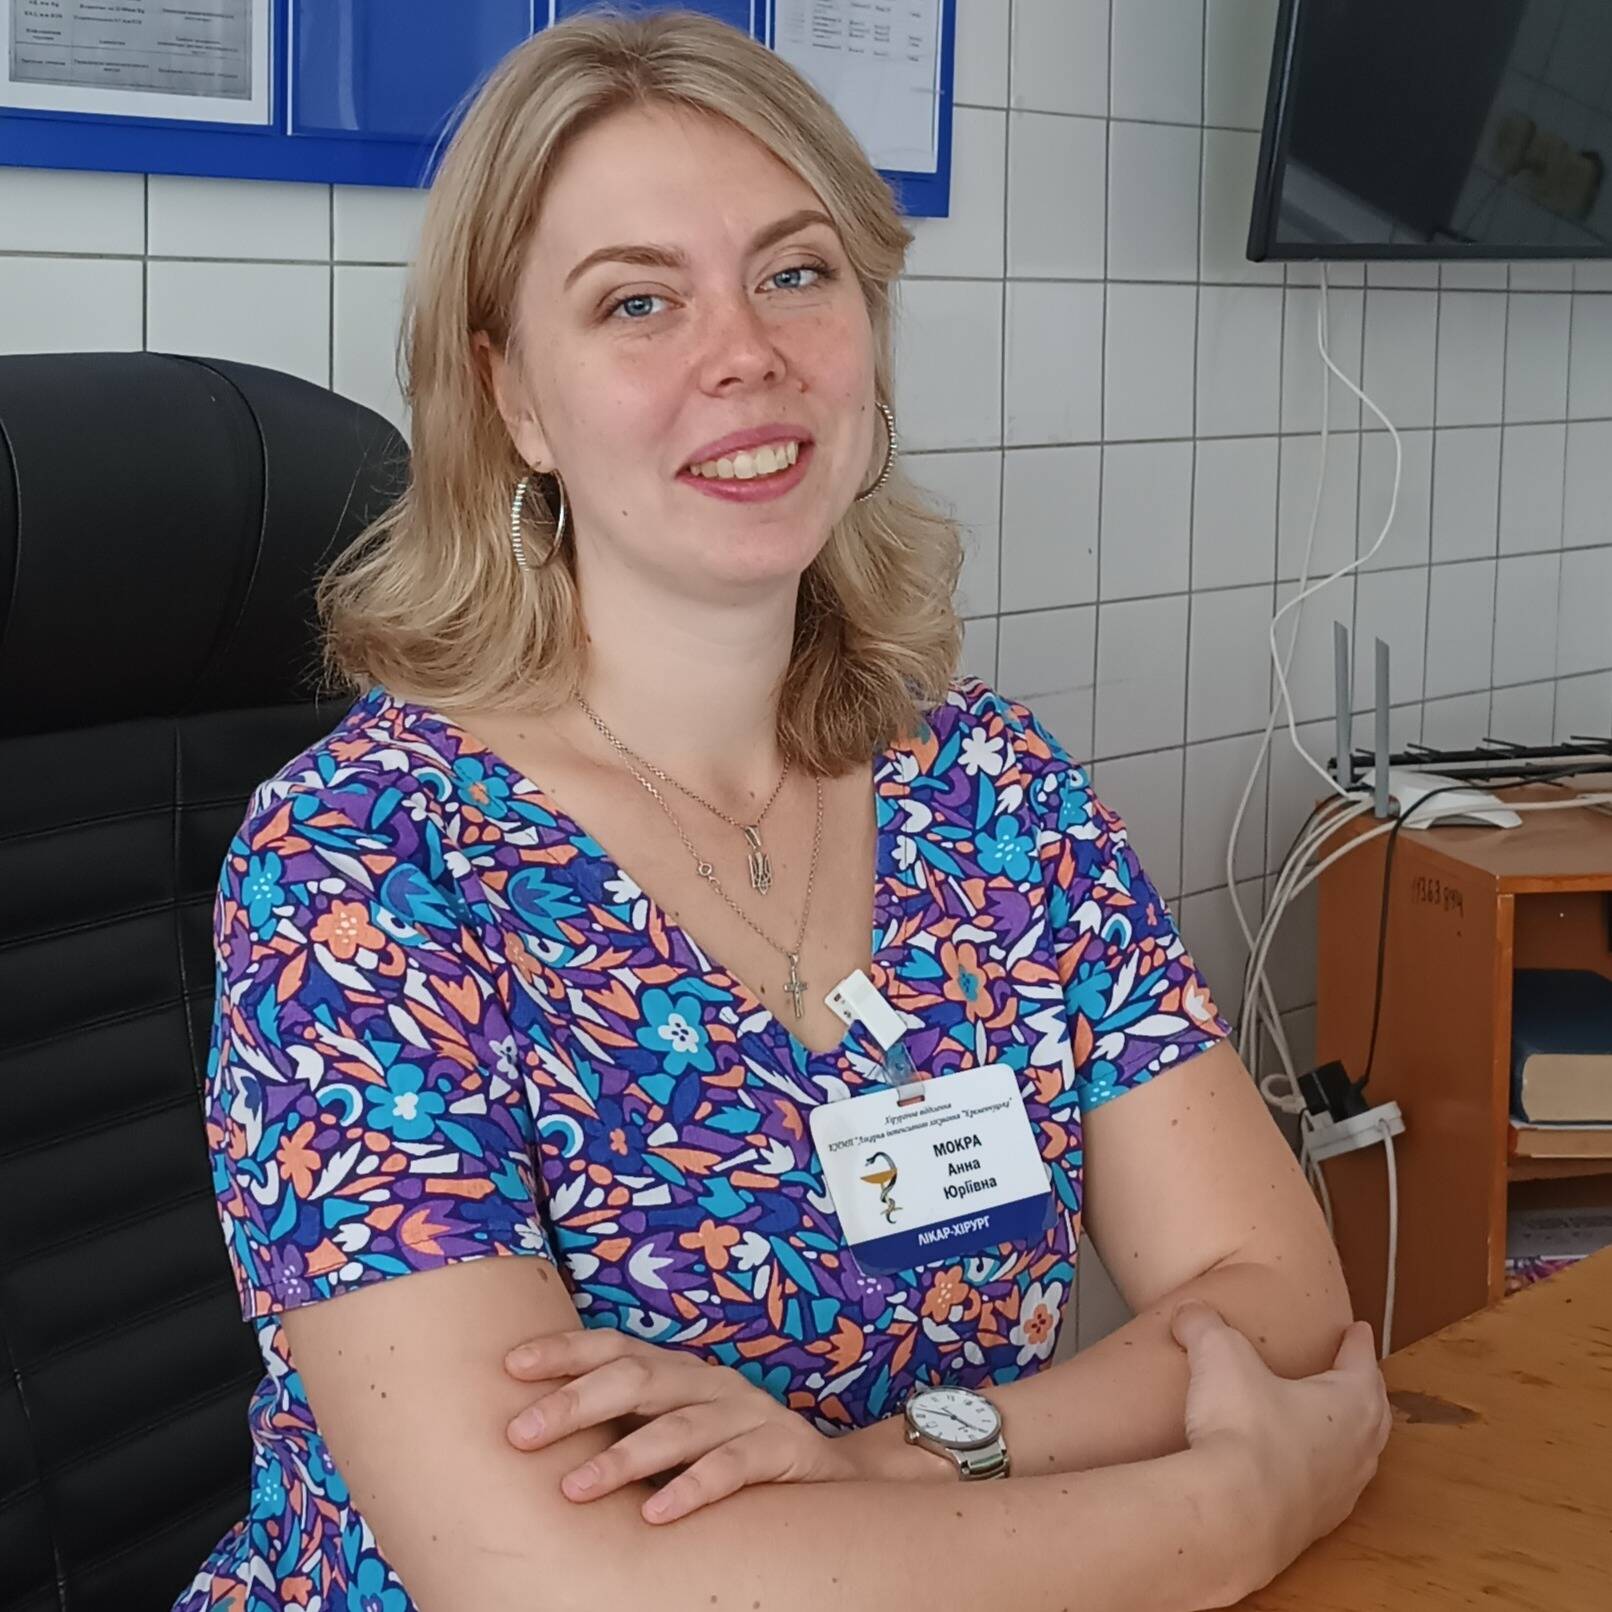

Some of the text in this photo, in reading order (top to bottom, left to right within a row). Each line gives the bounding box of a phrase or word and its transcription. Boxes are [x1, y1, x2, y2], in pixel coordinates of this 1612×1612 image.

[933, 1134, 982, 1158] МОКРА
[948, 1159, 981, 1176] Анна
[943, 1177, 998, 1200] Юріївна
[918, 1215, 990, 1246] ЛІКАР-ХІРУРГ
